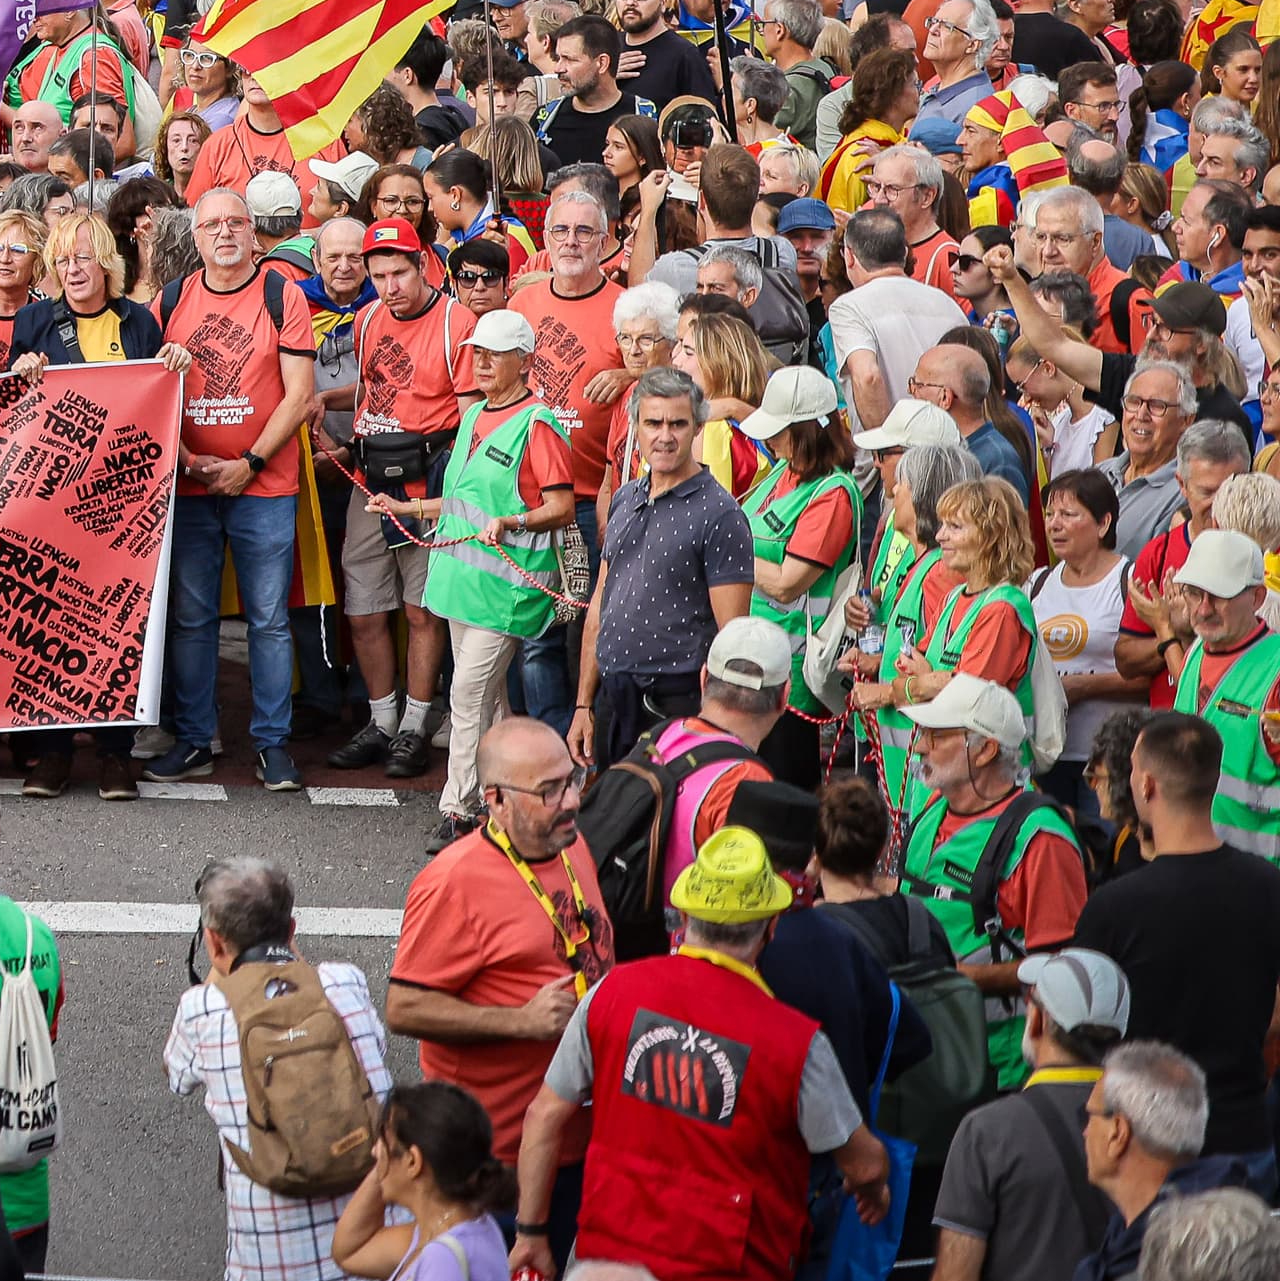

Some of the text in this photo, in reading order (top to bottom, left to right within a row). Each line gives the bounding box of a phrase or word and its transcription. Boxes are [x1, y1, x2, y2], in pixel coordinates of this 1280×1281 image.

[64, 389, 108, 421] LLENGUA
[189, 394, 251, 409] independència
[209, 405, 255, 417] MOTIUS
[43, 410, 97, 454] TERRA
[193, 415, 244, 426] QUE MAI
[13, 445, 41, 477] TERRA
[76, 463, 156, 502] LLIBERTAT
[29, 536, 80, 573] LLENGUA
[105, 577, 133, 607] TERRA
[82, 599, 109, 619] TERRA
[7, 617, 97, 675] NACIÓ
[11, 675, 45, 705] TERRA
[15, 656, 94, 711] LLENGUA
